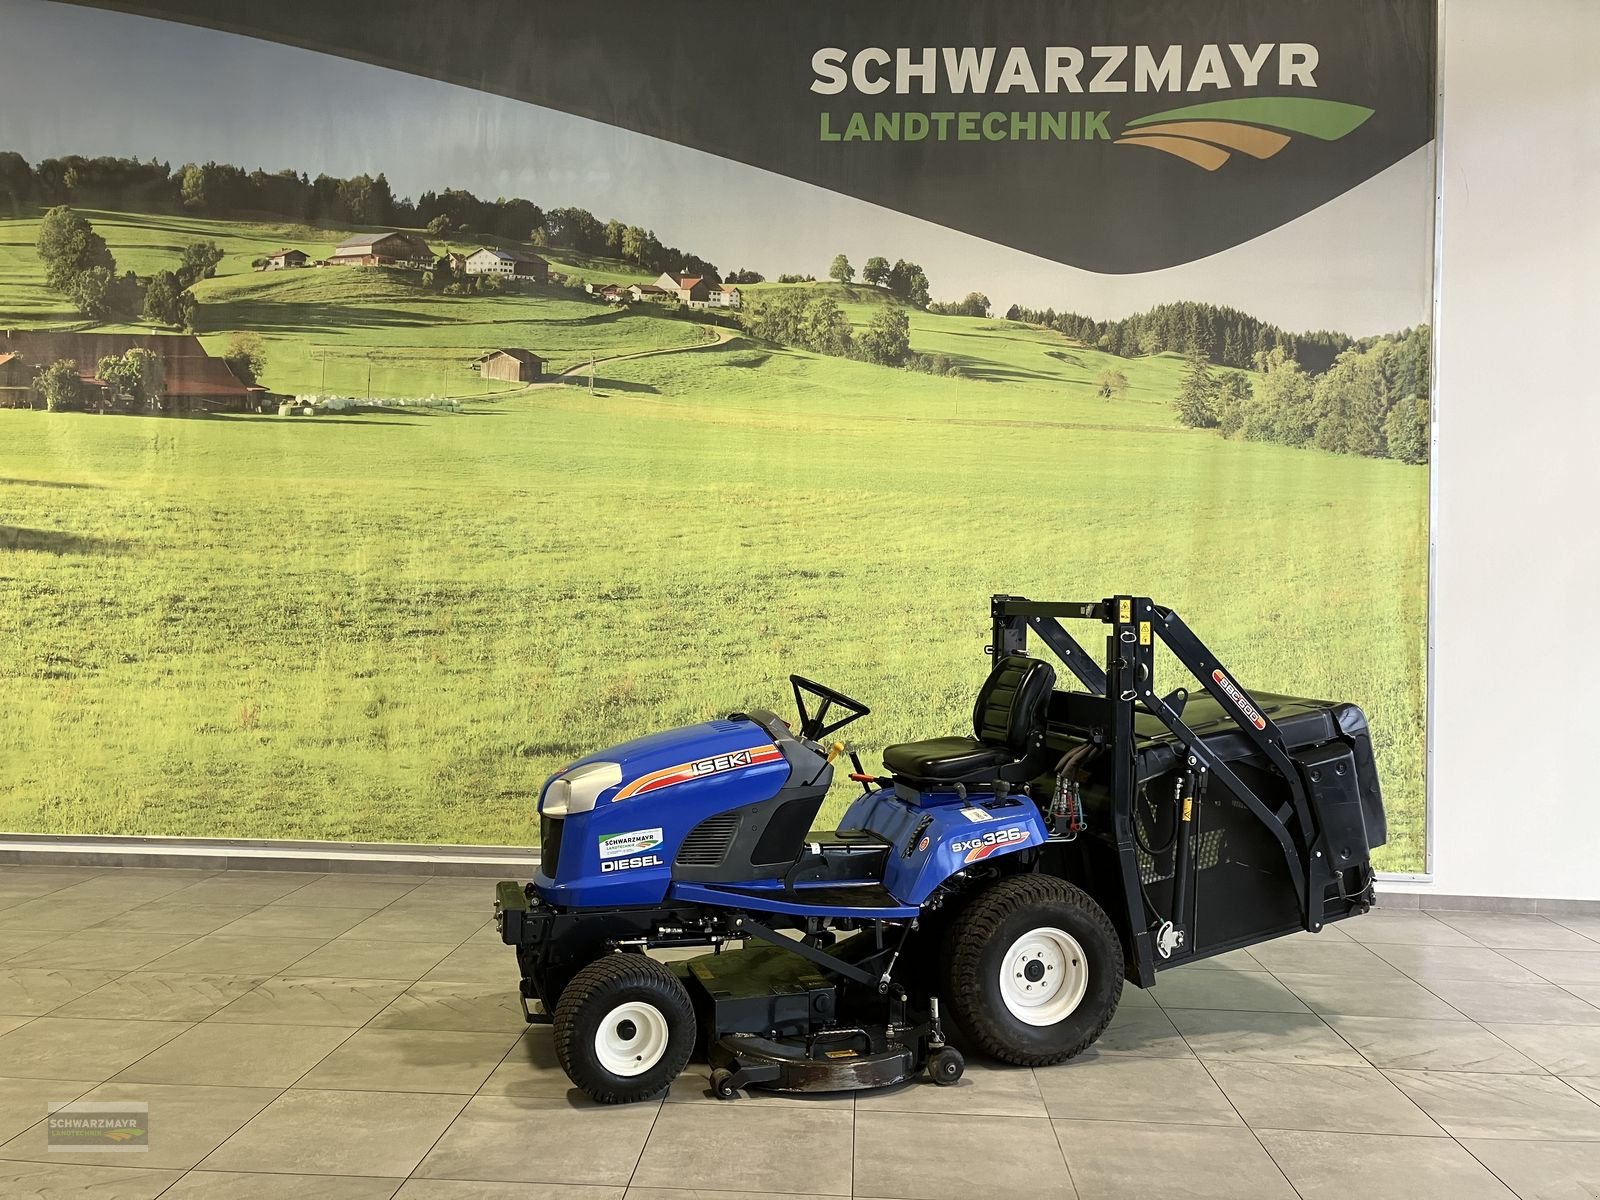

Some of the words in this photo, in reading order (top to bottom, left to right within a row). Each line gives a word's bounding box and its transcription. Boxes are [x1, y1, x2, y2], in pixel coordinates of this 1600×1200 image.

[810, 42, 1320, 95] SCHWARZMAYR
[819, 110, 1111, 142] LANDTECHNIK
[692, 750, 753, 777] ISEKI
[604, 834, 654, 847] SCHWARZMAYR
[601, 855, 663, 872] DIESEL
